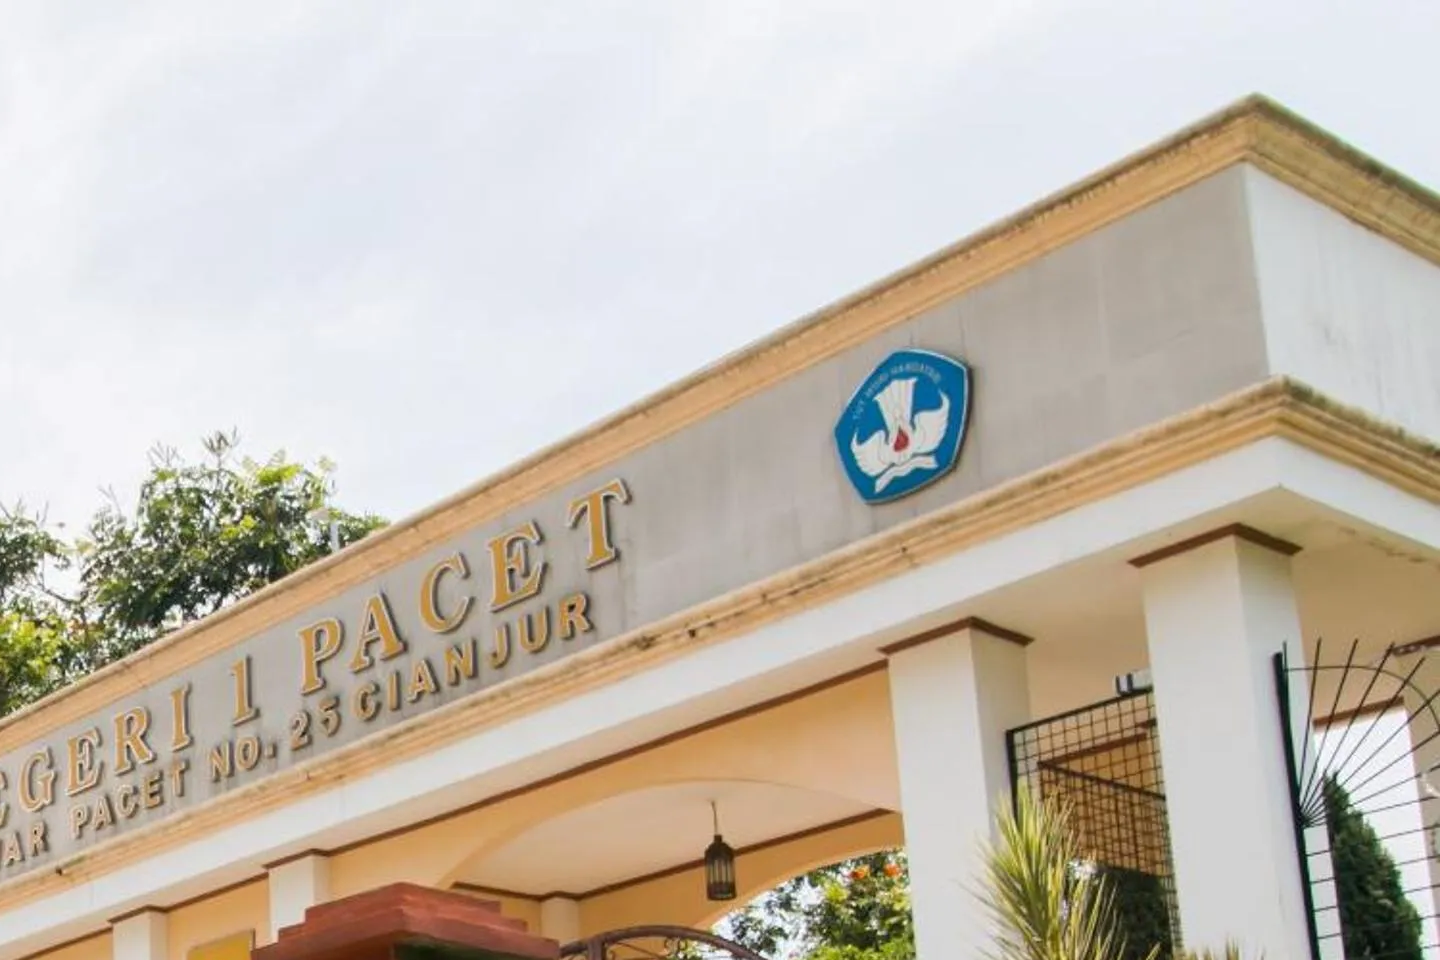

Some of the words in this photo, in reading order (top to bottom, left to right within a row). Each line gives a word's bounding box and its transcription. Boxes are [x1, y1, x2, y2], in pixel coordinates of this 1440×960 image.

[298, 477, 632, 697] PACET
[70, 758, 189, 840] PACET
[208, 736, 278, 783] NO.
[289, 697, 340, 752] 25
[352, 592, 596, 723] CIANJUR
